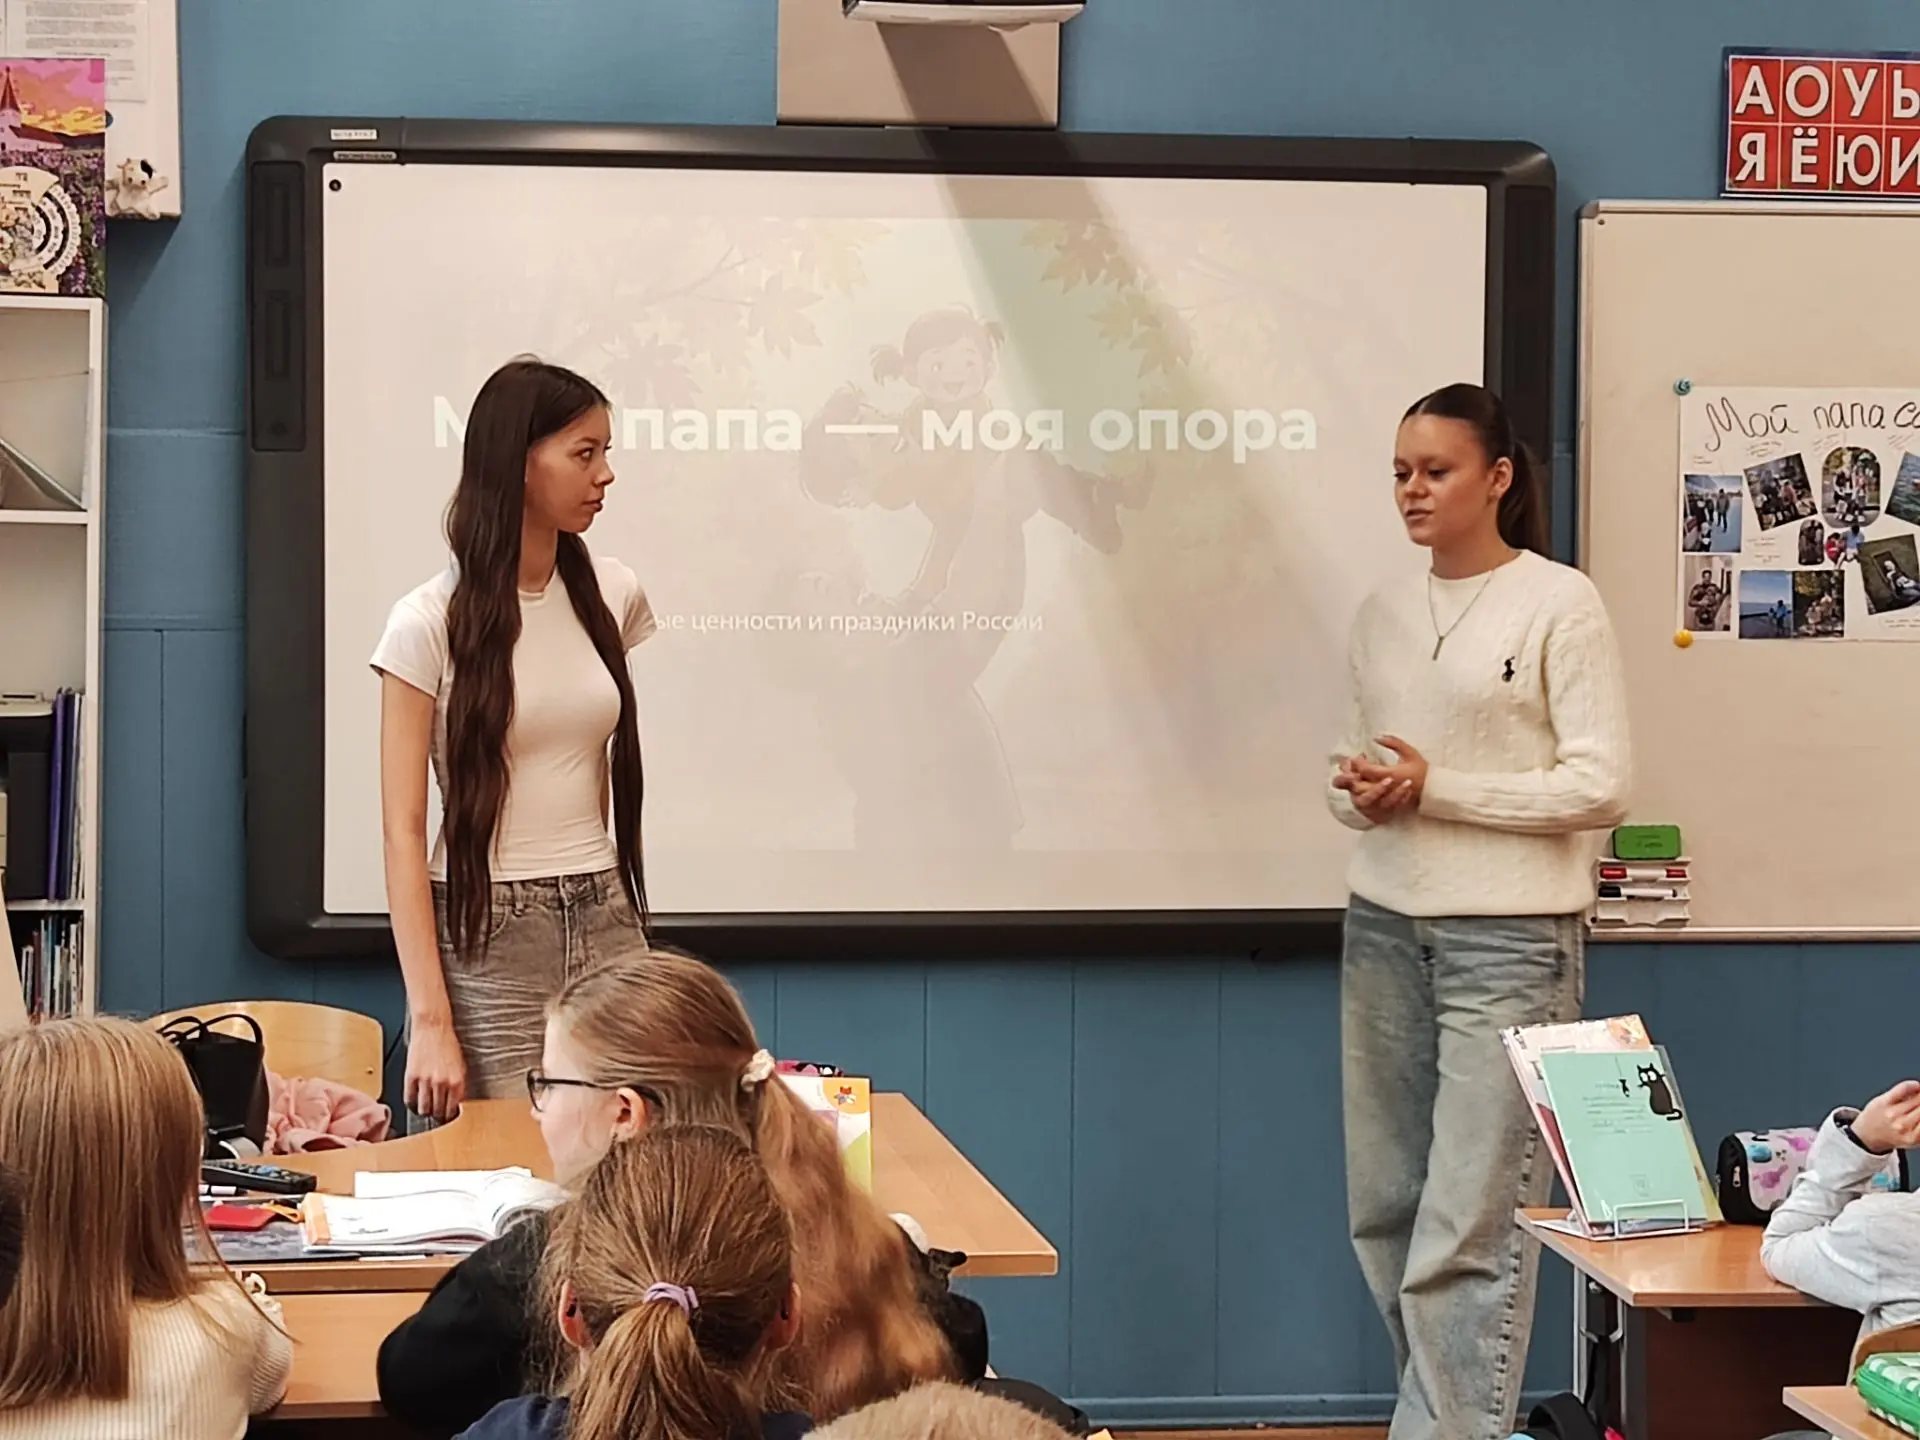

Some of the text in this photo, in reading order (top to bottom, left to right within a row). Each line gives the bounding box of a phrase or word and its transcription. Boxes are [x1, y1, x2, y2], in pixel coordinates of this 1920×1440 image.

[1734, 65, 1775, 115] А
[1785, 65, 1830, 117] О
[1841, 67, 1879, 117] У
[1734, 132, 1767, 182] Я
[1790, 127, 1819, 183] Ё
[1835, 134, 1881, 186] Ю
[622, 407, 803, 452] папа
[921, 409, 1064, 451] моя
[1088, 408, 1318, 463] опора
[1704, 396, 1799, 452] Мой
[1813, 402, 1886, 430] папа
[691, 614, 801, 634] ценности
[808, 615, 822, 630] и
[830, 614, 955, 636] праздники
[962, 612, 1044, 631] России
